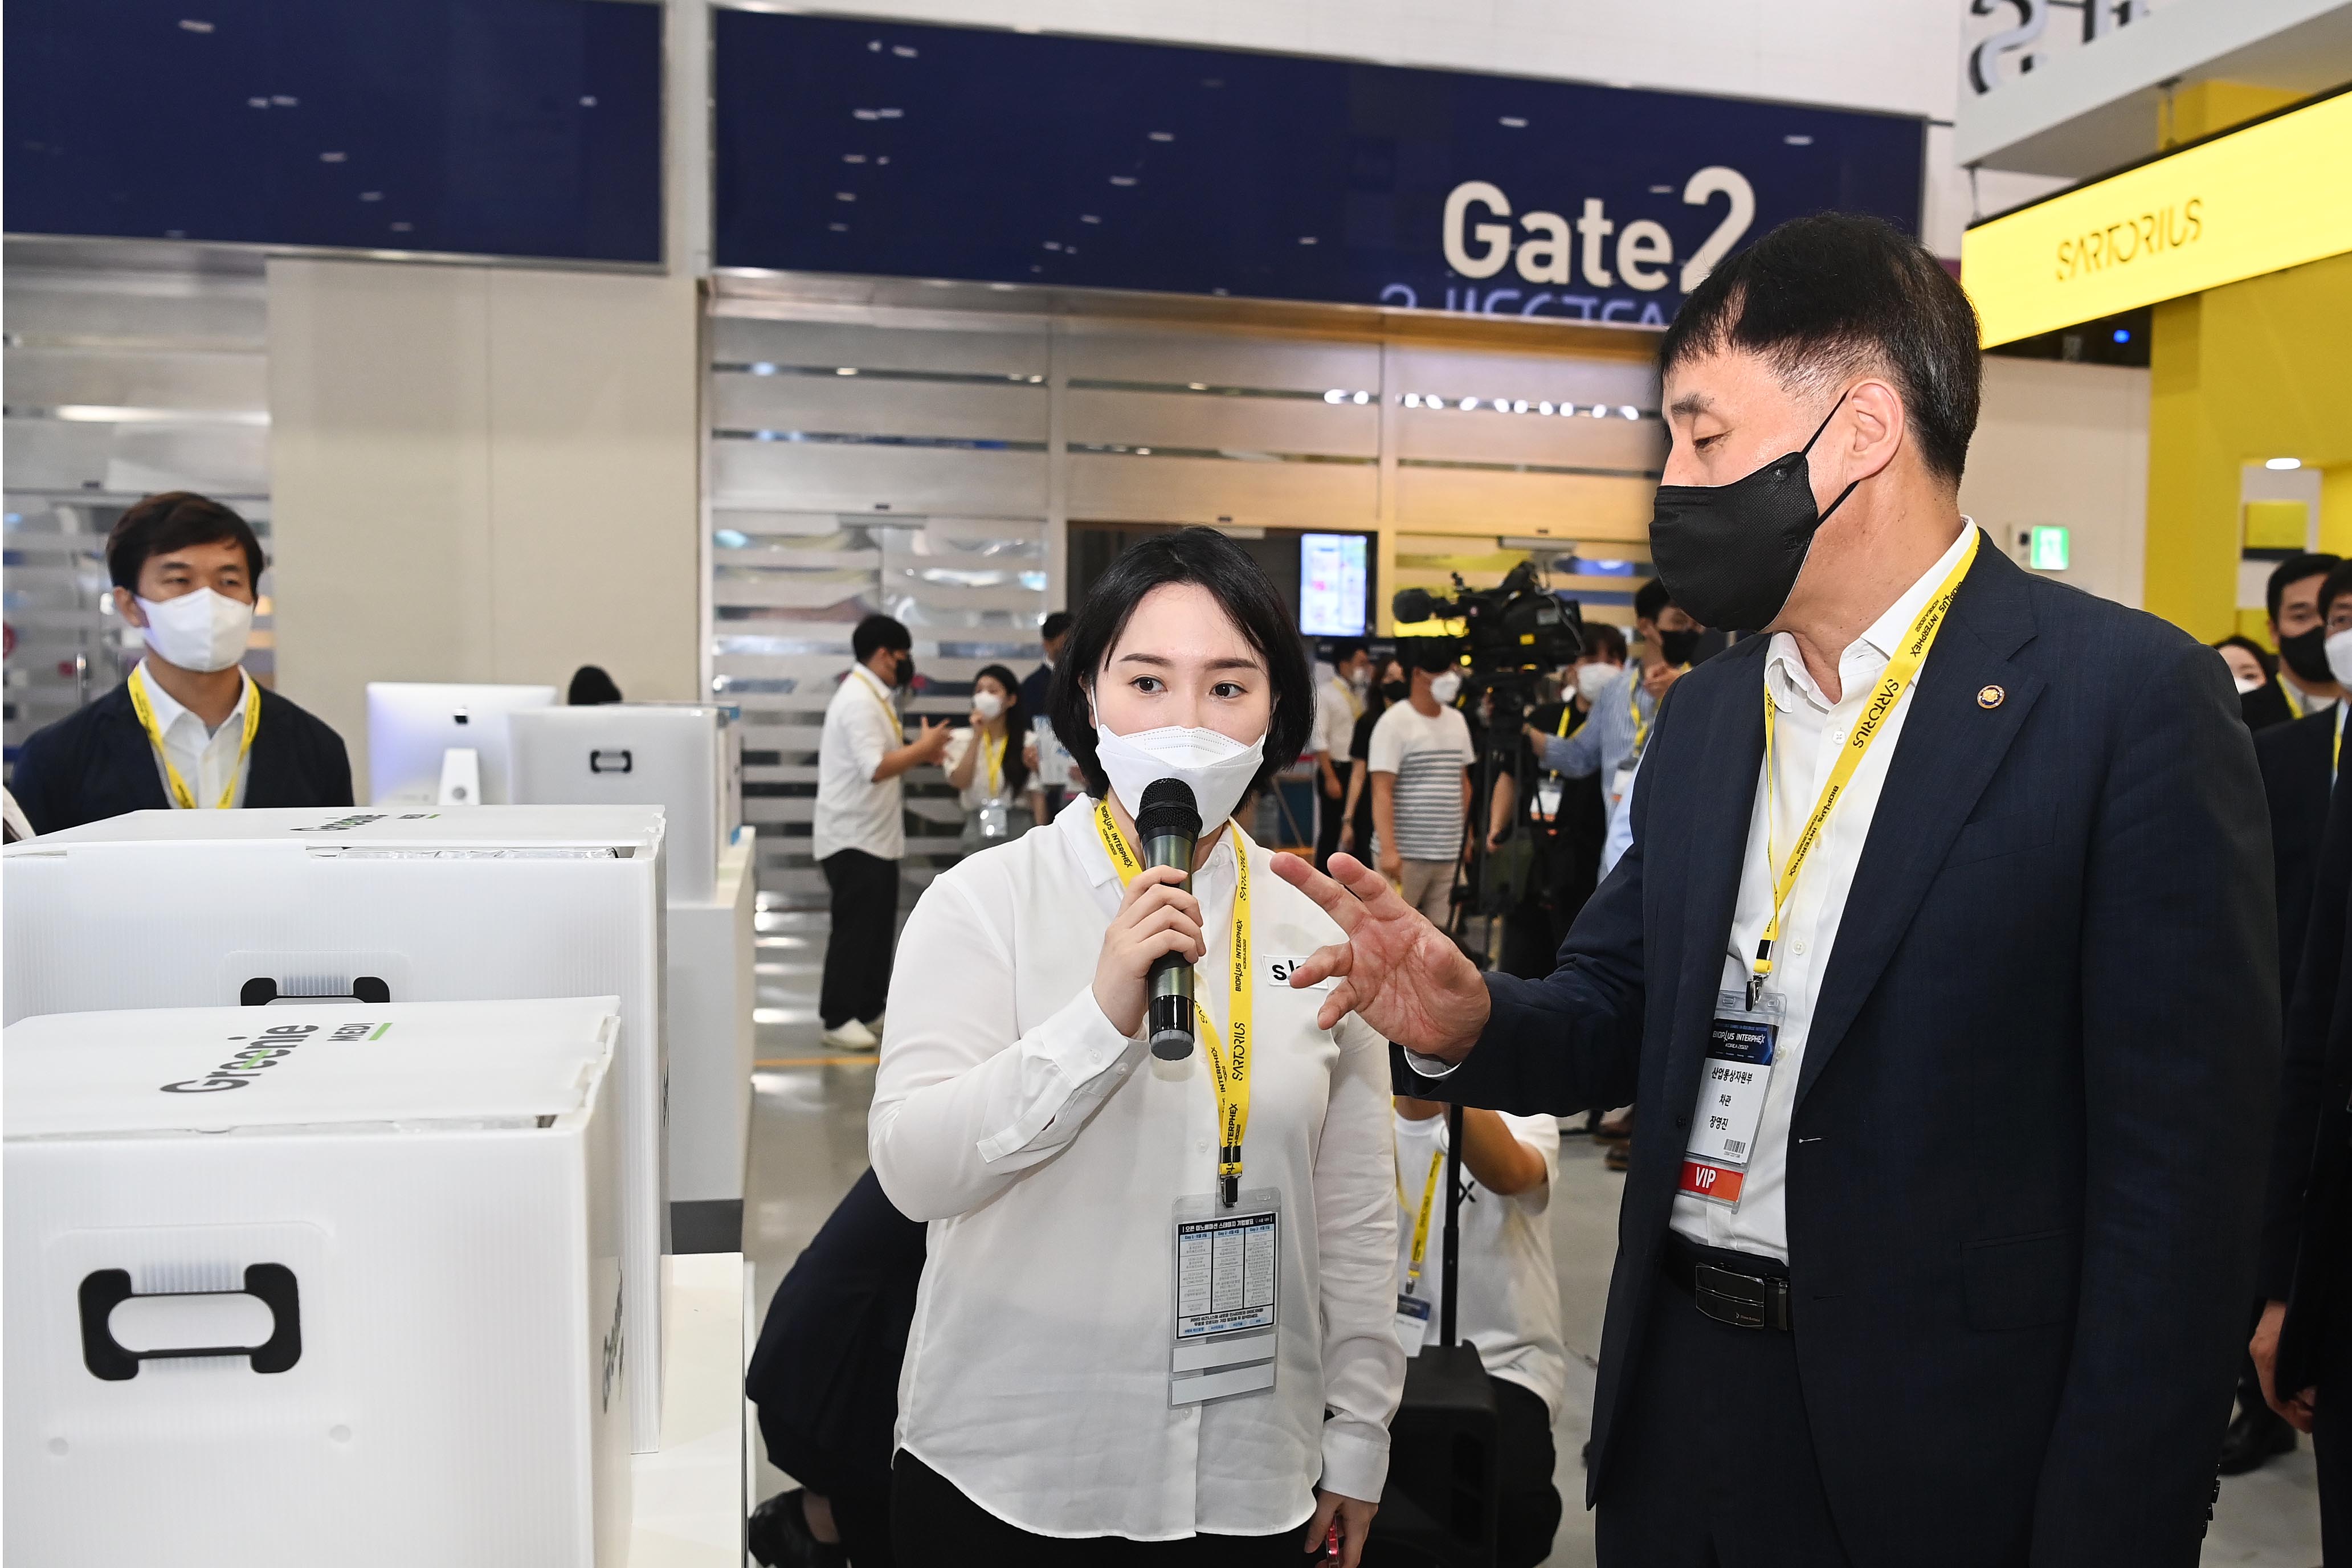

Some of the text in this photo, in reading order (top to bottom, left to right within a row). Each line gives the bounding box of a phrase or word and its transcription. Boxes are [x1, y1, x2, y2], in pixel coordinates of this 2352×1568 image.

[1443, 166, 1756, 293] Gate 2
[2055, 197, 2204, 281] SARTORIUS
[1910, 614, 1939, 658] INTERPHEX
[1853, 679, 1900, 748] SARTORIUS
[1101, 806, 1133, 868] BIOPLUS INTERPHEX
[1238, 847, 1247, 901] SARTORIUS
[1234, 962, 1243, 991] BIOPLUS
[327, 1023, 375, 1042] MEDI
[1232, 1022, 1245, 1081] SARTORIUS
[1736, 1033, 1765, 1044] INTERPHEX
[160, 1024, 319, 1093] Greenie
[1211, 1047, 1226, 1093] INTERPHEX
[1712, 1067, 1753, 1085] 산업통상자원부
[1718, 1093, 1732, 1106] 차관
[1227, 1103, 1238, 1147] NTERPHEX
[1709, 1115, 1729, 1130] 장영진
[1695, 1166, 1716, 1189] VIP
